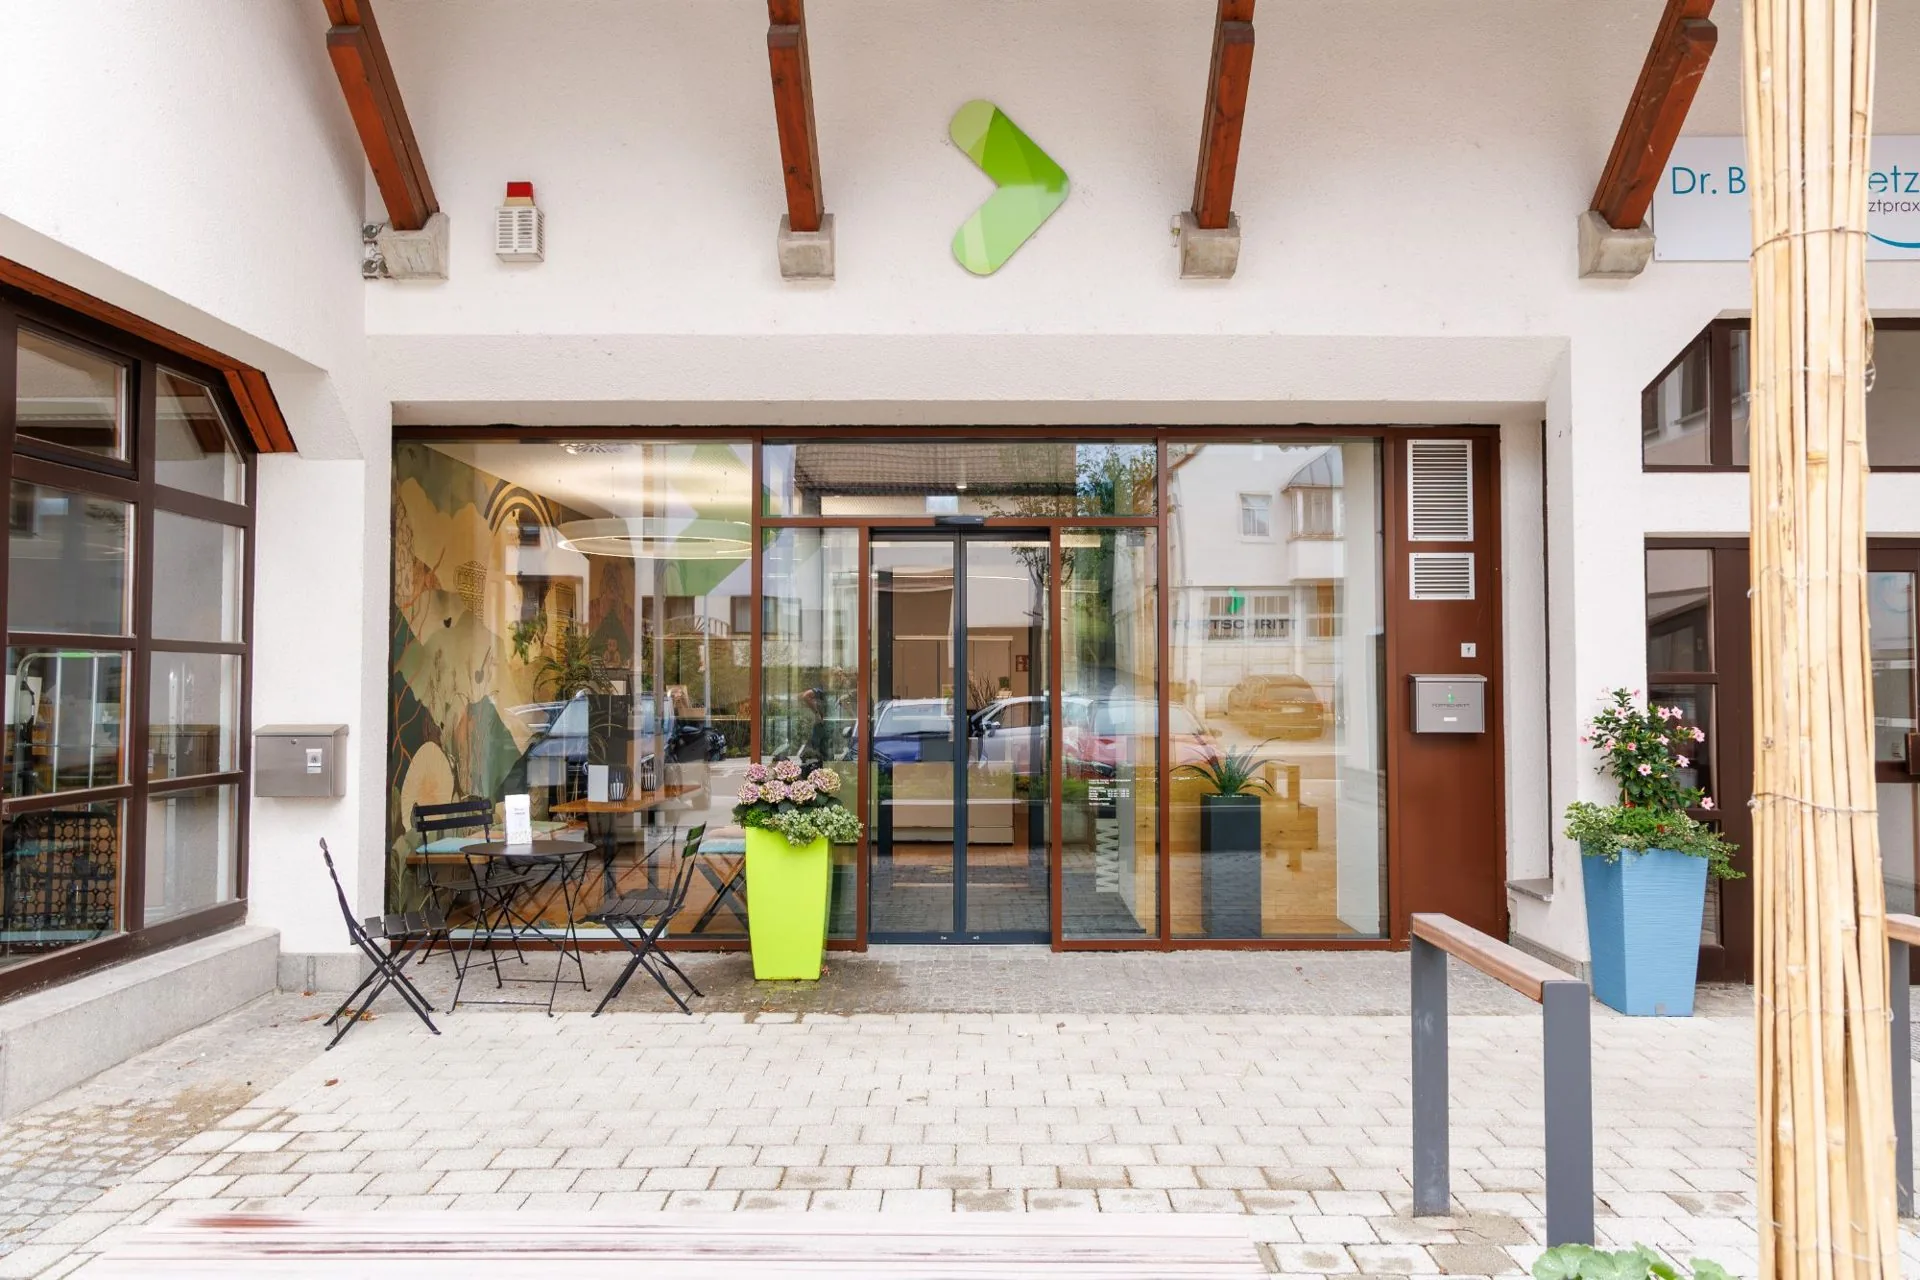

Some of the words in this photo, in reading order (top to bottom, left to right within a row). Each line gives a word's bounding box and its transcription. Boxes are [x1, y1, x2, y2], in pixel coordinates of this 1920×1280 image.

[1672, 166, 1717, 195] Dr.
[1728, 166, 1747, 194] B
[1868, 164, 1920, 193] etz
[1868, 199, 1920, 215] ztprax
